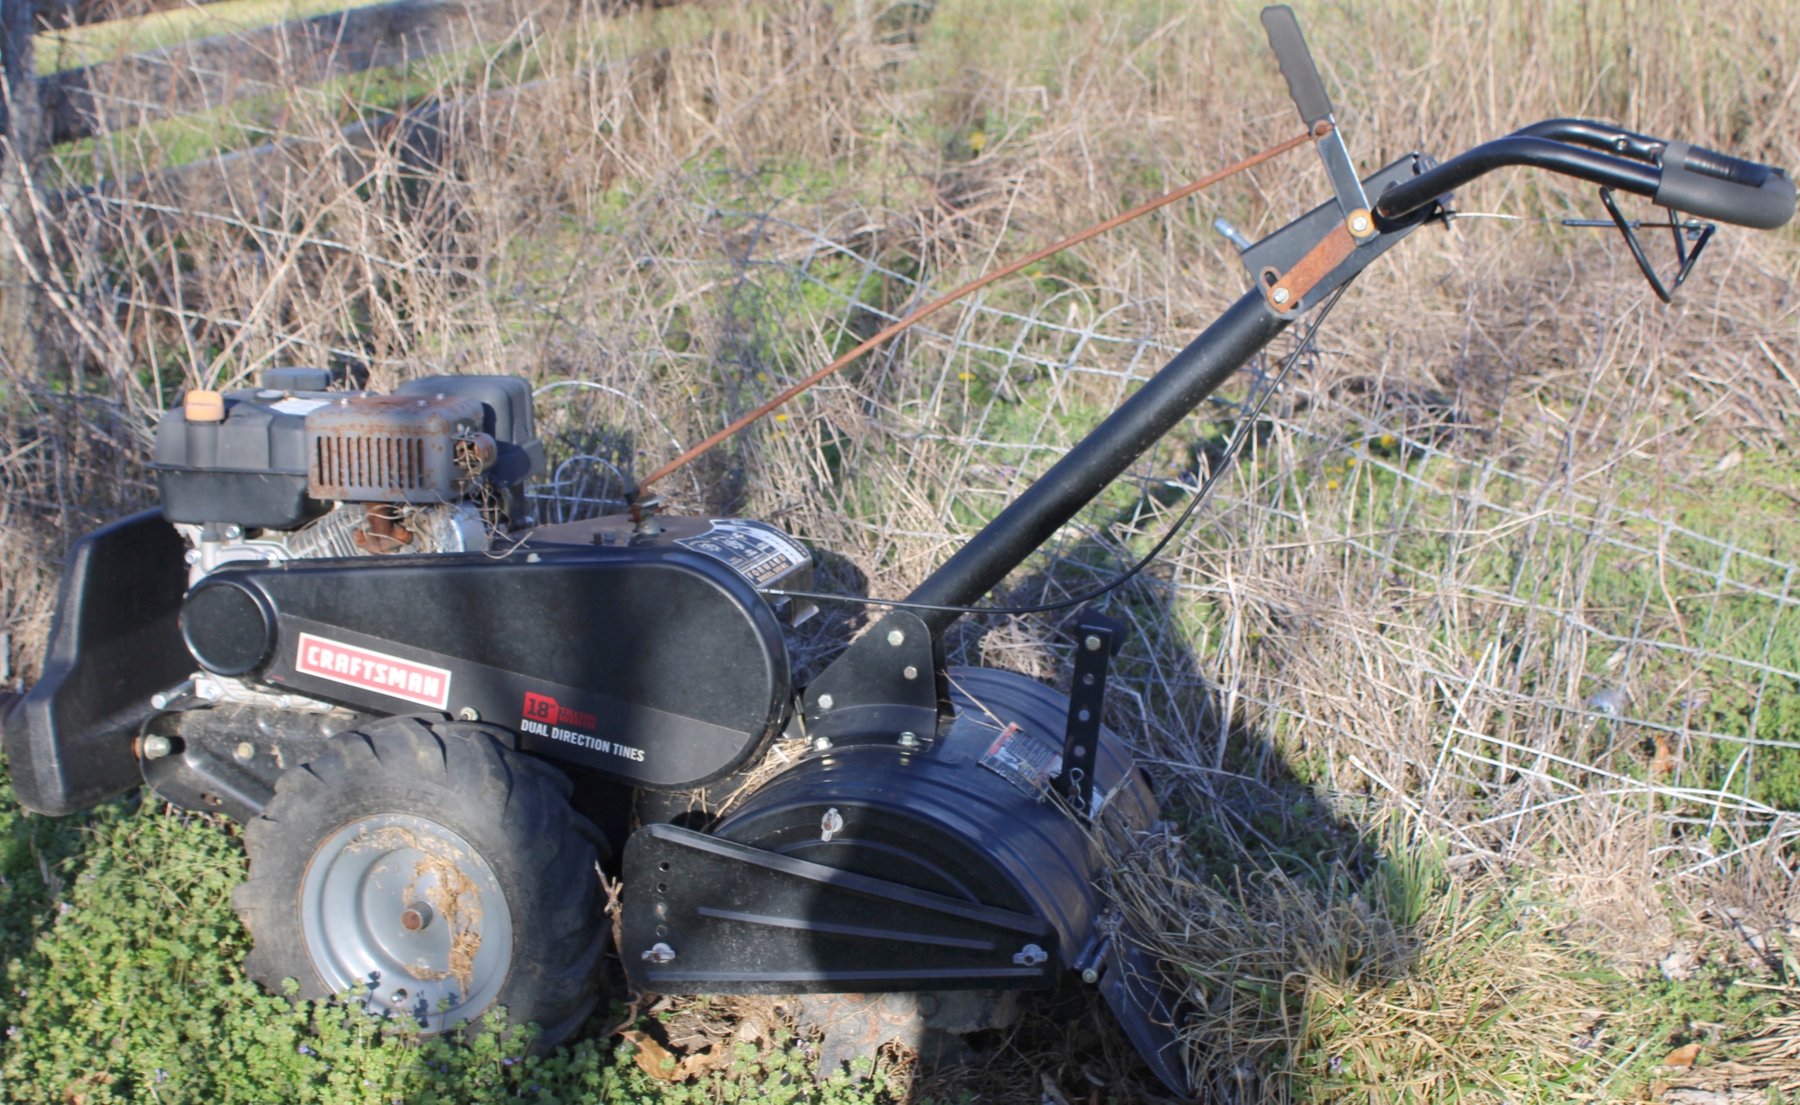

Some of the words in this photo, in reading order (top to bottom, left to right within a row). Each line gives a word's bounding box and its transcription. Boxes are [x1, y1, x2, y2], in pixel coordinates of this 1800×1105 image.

[307, 645, 440, 698] CRAFTSMAN
[520, 719, 549, 737] DUAL
[551, 727, 611, 753] DIRECTION
[612, 742, 645, 762] TINES
